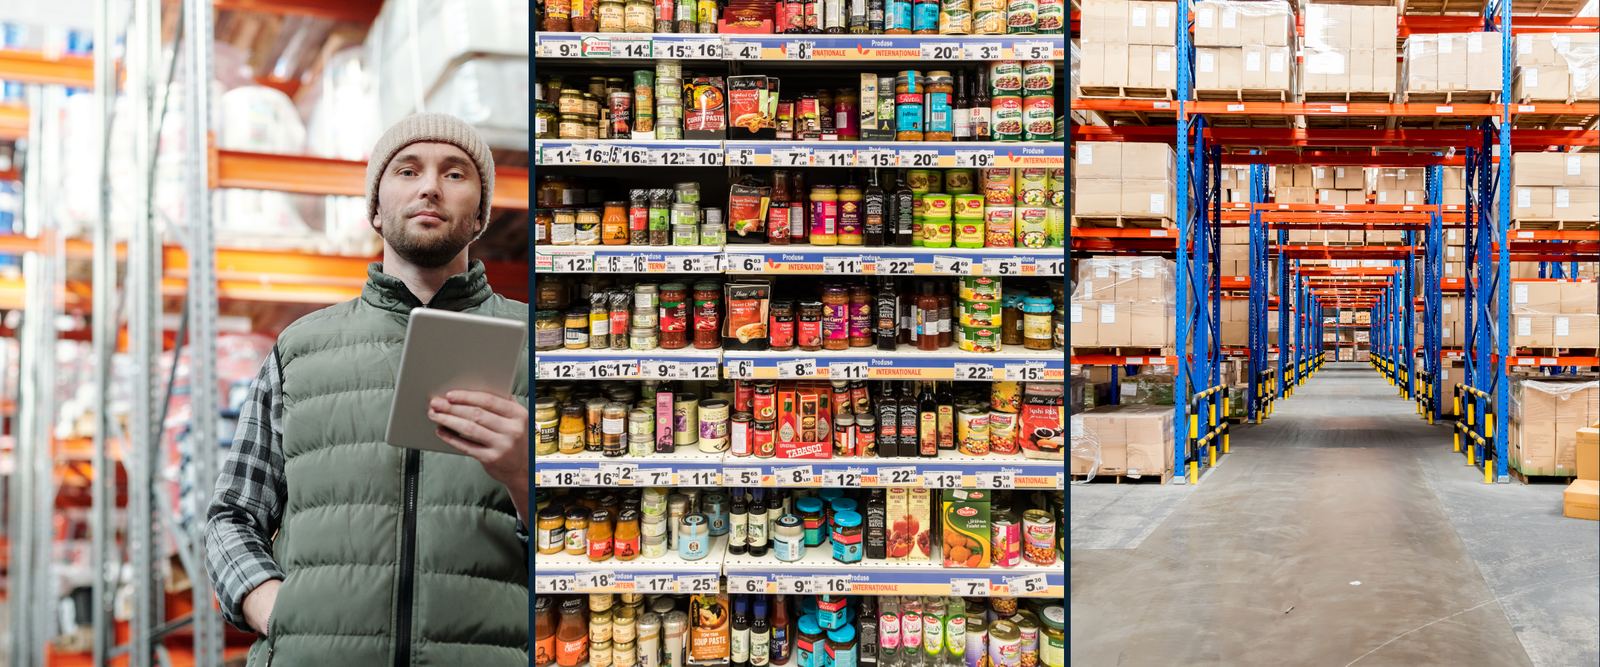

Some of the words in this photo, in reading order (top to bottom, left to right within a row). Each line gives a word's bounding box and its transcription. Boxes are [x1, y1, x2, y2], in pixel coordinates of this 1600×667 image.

[560, 44, 570, 56] 9
[625, 44, 643, 57] 14
[667, 45, 685, 58] 15
[698, 43, 716, 57] 16
[740, 46, 750, 59] 4
[798, 43, 806, 59] 8
[934, 46, 953, 59] 20
[981, 46, 991, 59] 3
[1031, 46, 1041, 59] 5
[585, 149, 602, 163] 16
[622, 150, 641, 163] 16
[739, 150, 748, 165] 5
[1022, 147, 1044, 155] Produse
[661, 152, 680, 165] 12
[699, 152, 717, 165] 10
[789, 153, 799, 165] 7
[829, 153, 847, 166] 11
[871, 153, 889, 166] 15
[914, 153, 933, 166] 20
[970, 154, 988, 167] 19
[714, 255, 720, 271] 7
[783, 253, 804, 261] Produse
[568, 259, 586, 271] 12
[608, 257, 617, 272] 15
[634, 257, 644, 272] 16
[683, 259, 693, 271] 8
[744, 258, 754, 271] 6
[838, 261, 854, 273] 11
[889, 262, 908, 274] 22
[950, 261, 961, 273] 4
[999, 262, 1009, 274] 5
[554, 365, 571, 377] 12
[590, 365, 607, 377] 16
[613, 363, 631, 377] 17
[658, 365, 668, 377] 9
[692, 366, 710, 378] 12
[739, 361, 746, 377] 6
[796, 363, 805, 376] 8
[844, 366, 861, 378] 11
[968, 367, 987, 379] 22
[1019, 367, 1037, 380] 15
[785, 443, 823, 458] TABASCO
[555, 473, 573, 485] 18
[594, 473, 612, 485] 16
[651, 472, 661, 485] 7
[692, 473, 710, 485] 11
[741, 471, 751, 484] 5
[793, 470, 803, 483] 8
[837, 474, 855, 487] 12
[892, 470, 910, 483] 22
[937, 475, 955, 488] 13
[992, 475, 1003, 488] 5
[550, 578, 568, 591] 13
[591, 575, 609, 587] 18
[650, 579, 667, 591] 17
[692, 578, 711, 591] 25
[746, 580, 756, 592] 6
[794, 581, 805, 593] 9
[827, 579, 845, 592] 16
[1025, 579, 1036, 592] 5
[967, 582, 978, 595] 7
[708, 636, 727, 646] PASTE
